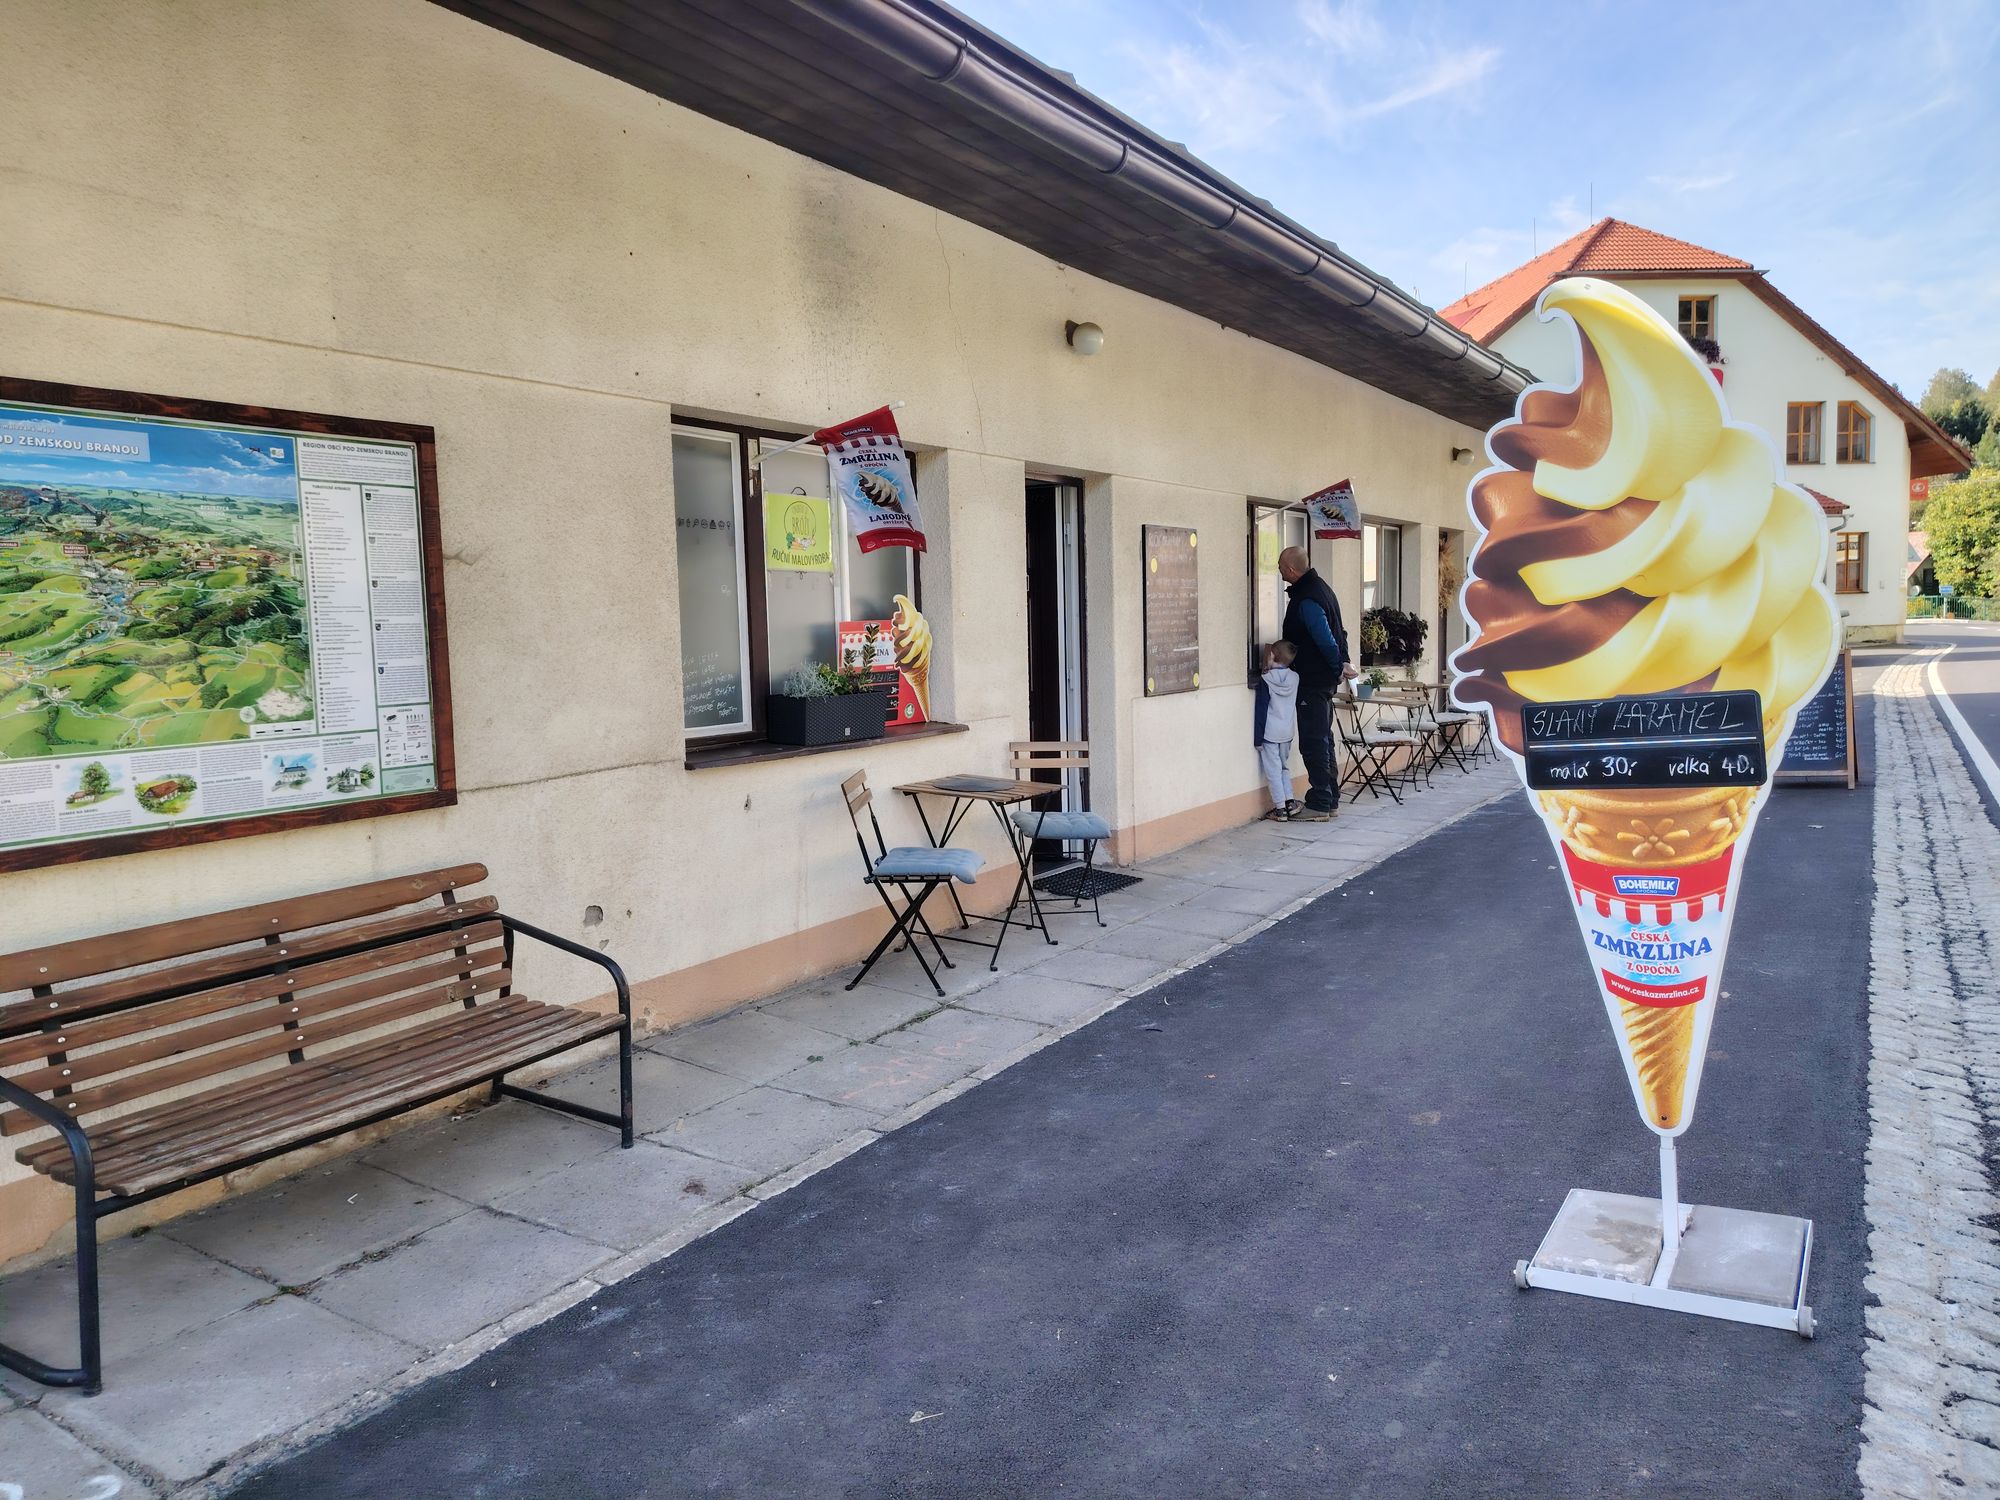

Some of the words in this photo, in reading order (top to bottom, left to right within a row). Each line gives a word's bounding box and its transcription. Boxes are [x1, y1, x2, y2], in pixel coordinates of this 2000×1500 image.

[18, 435, 82, 451] ZEMSKOU
[86, 442, 140, 456] BRANOU
[356, 447, 384, 455] ZEMSKOU
[839, 452, 900, 466] ZMRZLINA
[868, 513, 913, 523] LAHODNÉ
[771, 547, 791, 565] RUČNÍ
[1531, 702, 1604, 738] SLANÝ
[1613, 699, 1744, 735] KARAMEL
[1550, 760, 1591, 780] malá
[1618, 879, 1676, 891] BOHEMILK
[1631, 928, 1671, 942] ČESKÁ
[1591, 928, 1713, 961] ZMRZLINA
[1626, 961, 1634, 971] Z
[1635, 963, 1681, 975] OPOČNA
[1610, 979, 1700, 999] www.ceskazmrzlina.cz
